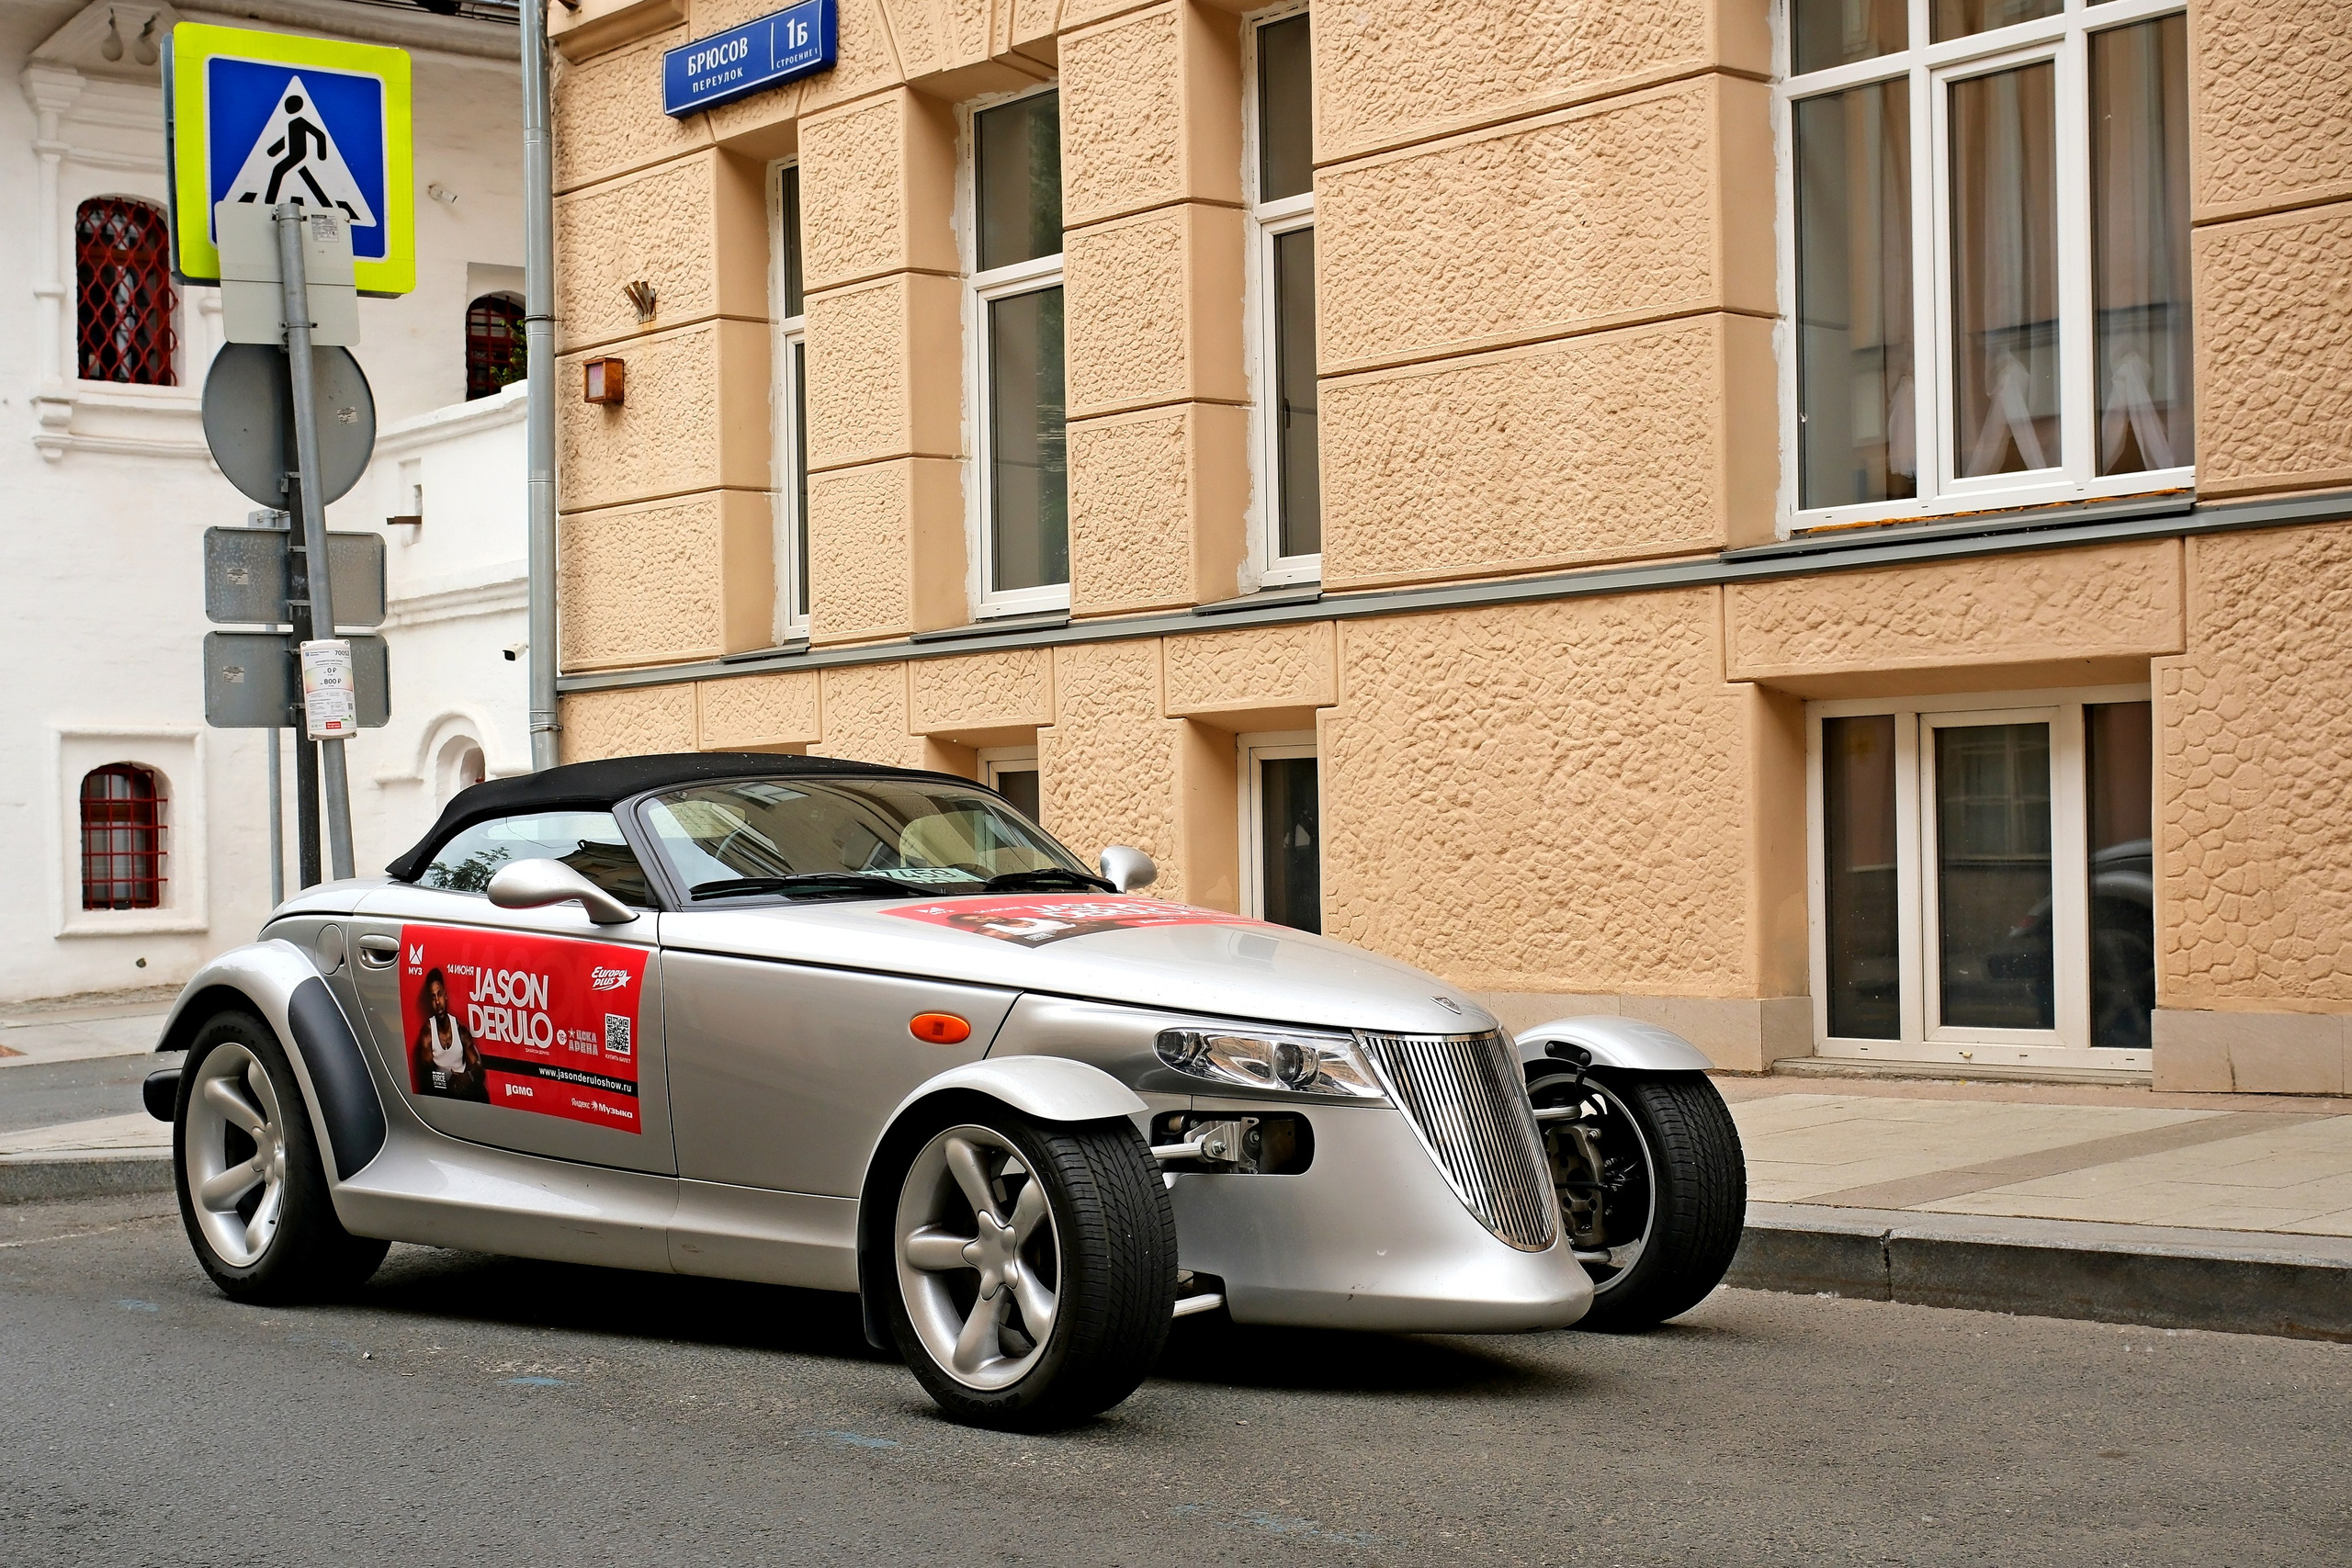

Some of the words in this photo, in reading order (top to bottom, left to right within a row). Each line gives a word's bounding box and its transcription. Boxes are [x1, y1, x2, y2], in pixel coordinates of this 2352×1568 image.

[786, 18, 808, 50] 1Б
[688, 38, 748, 76] БРЮСОВ
[776, 49, 812, 69] СТРОЕНИЕ
[693, 67, 743, 93] ПЕРЕУЛОК
[408, 967, 423, 976] МУЗ
[447, 964, 454, 974] 14
[455, 964, 474, 976] ИЮНЯ
[469, 967, 548, 1010] JASON
[468, 1004, 553, 1049] DERULO
[569, 1040, 598, 1055] АРЕНА
[539, 1067, 631, 1092] www.jasonderuloshow.ru
[512, 1086, 533, 1097] GMG
[571, 1098, 590, 1109] Яндекс
[598, 1102, 633, 1119] Музыка
